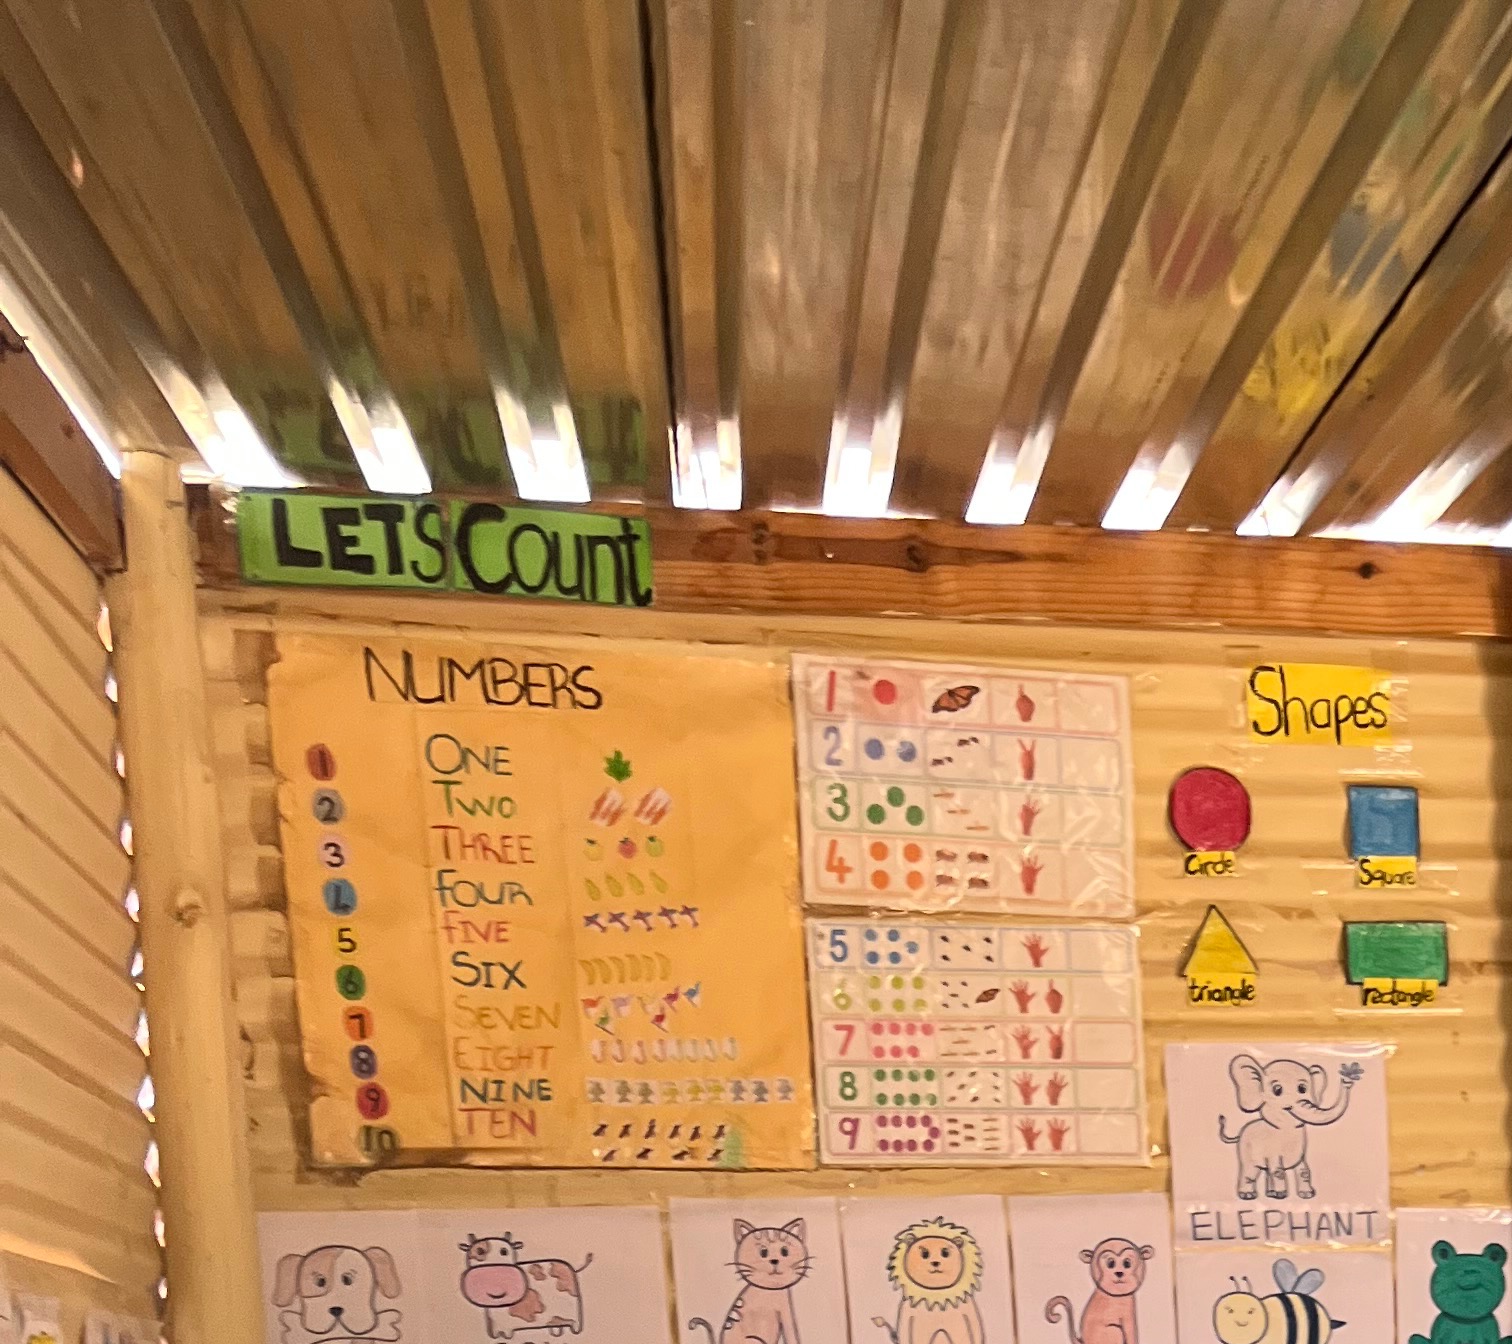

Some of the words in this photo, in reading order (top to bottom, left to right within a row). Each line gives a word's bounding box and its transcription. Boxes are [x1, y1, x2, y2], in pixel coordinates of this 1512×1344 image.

[272, 498, 446, 583] LETS
[455, 503, 653, 606] Count
[363, 646, 603, 710] NUMBERS
[826, 670, 836, 713] 1
[1248, 665, 1390, 745] Shapes
[425, 733, 513, 776] ONE
[823, 726, 843, 766] 2
[317, 796, 339, 823] 2
[826, 783, 851, 822] 3
[323, 842, 345, 868] 3
[430, 825, 535, 864] THREE
[825, 839, 855, 884] 4
[433, 868, 534, 908] FOUR
[1359, 858, 1416, 887] Square
[337, 927, 357, 953] 5
[441, 910, 512, 944] FIVE
[830, 929, 848, 963] 5
[451, 951, 527, 990] SIX
[833, 978, 852, 1011] 6
[1188, 977, 1256, 1005] triangle
[1361, 979, 1436, 1007] rectangle
[348, 1013, 367, 1039] 7
[452, 994, 562, 1031] SEVEN
[453, 1036, 555, 1071] EIGHT
[833, 1024, 855, 1057] 7
[460, 1077, 553, 1104] NINE
[839, 1071, 858, 1101] 8
[362, 1125, 395, 1153] 10
[457, 1107, 538, 1138] TEN
[838, 1116, 860, 1150] 9
[1190, 1208, 1379, 1242] ELEPHANT
